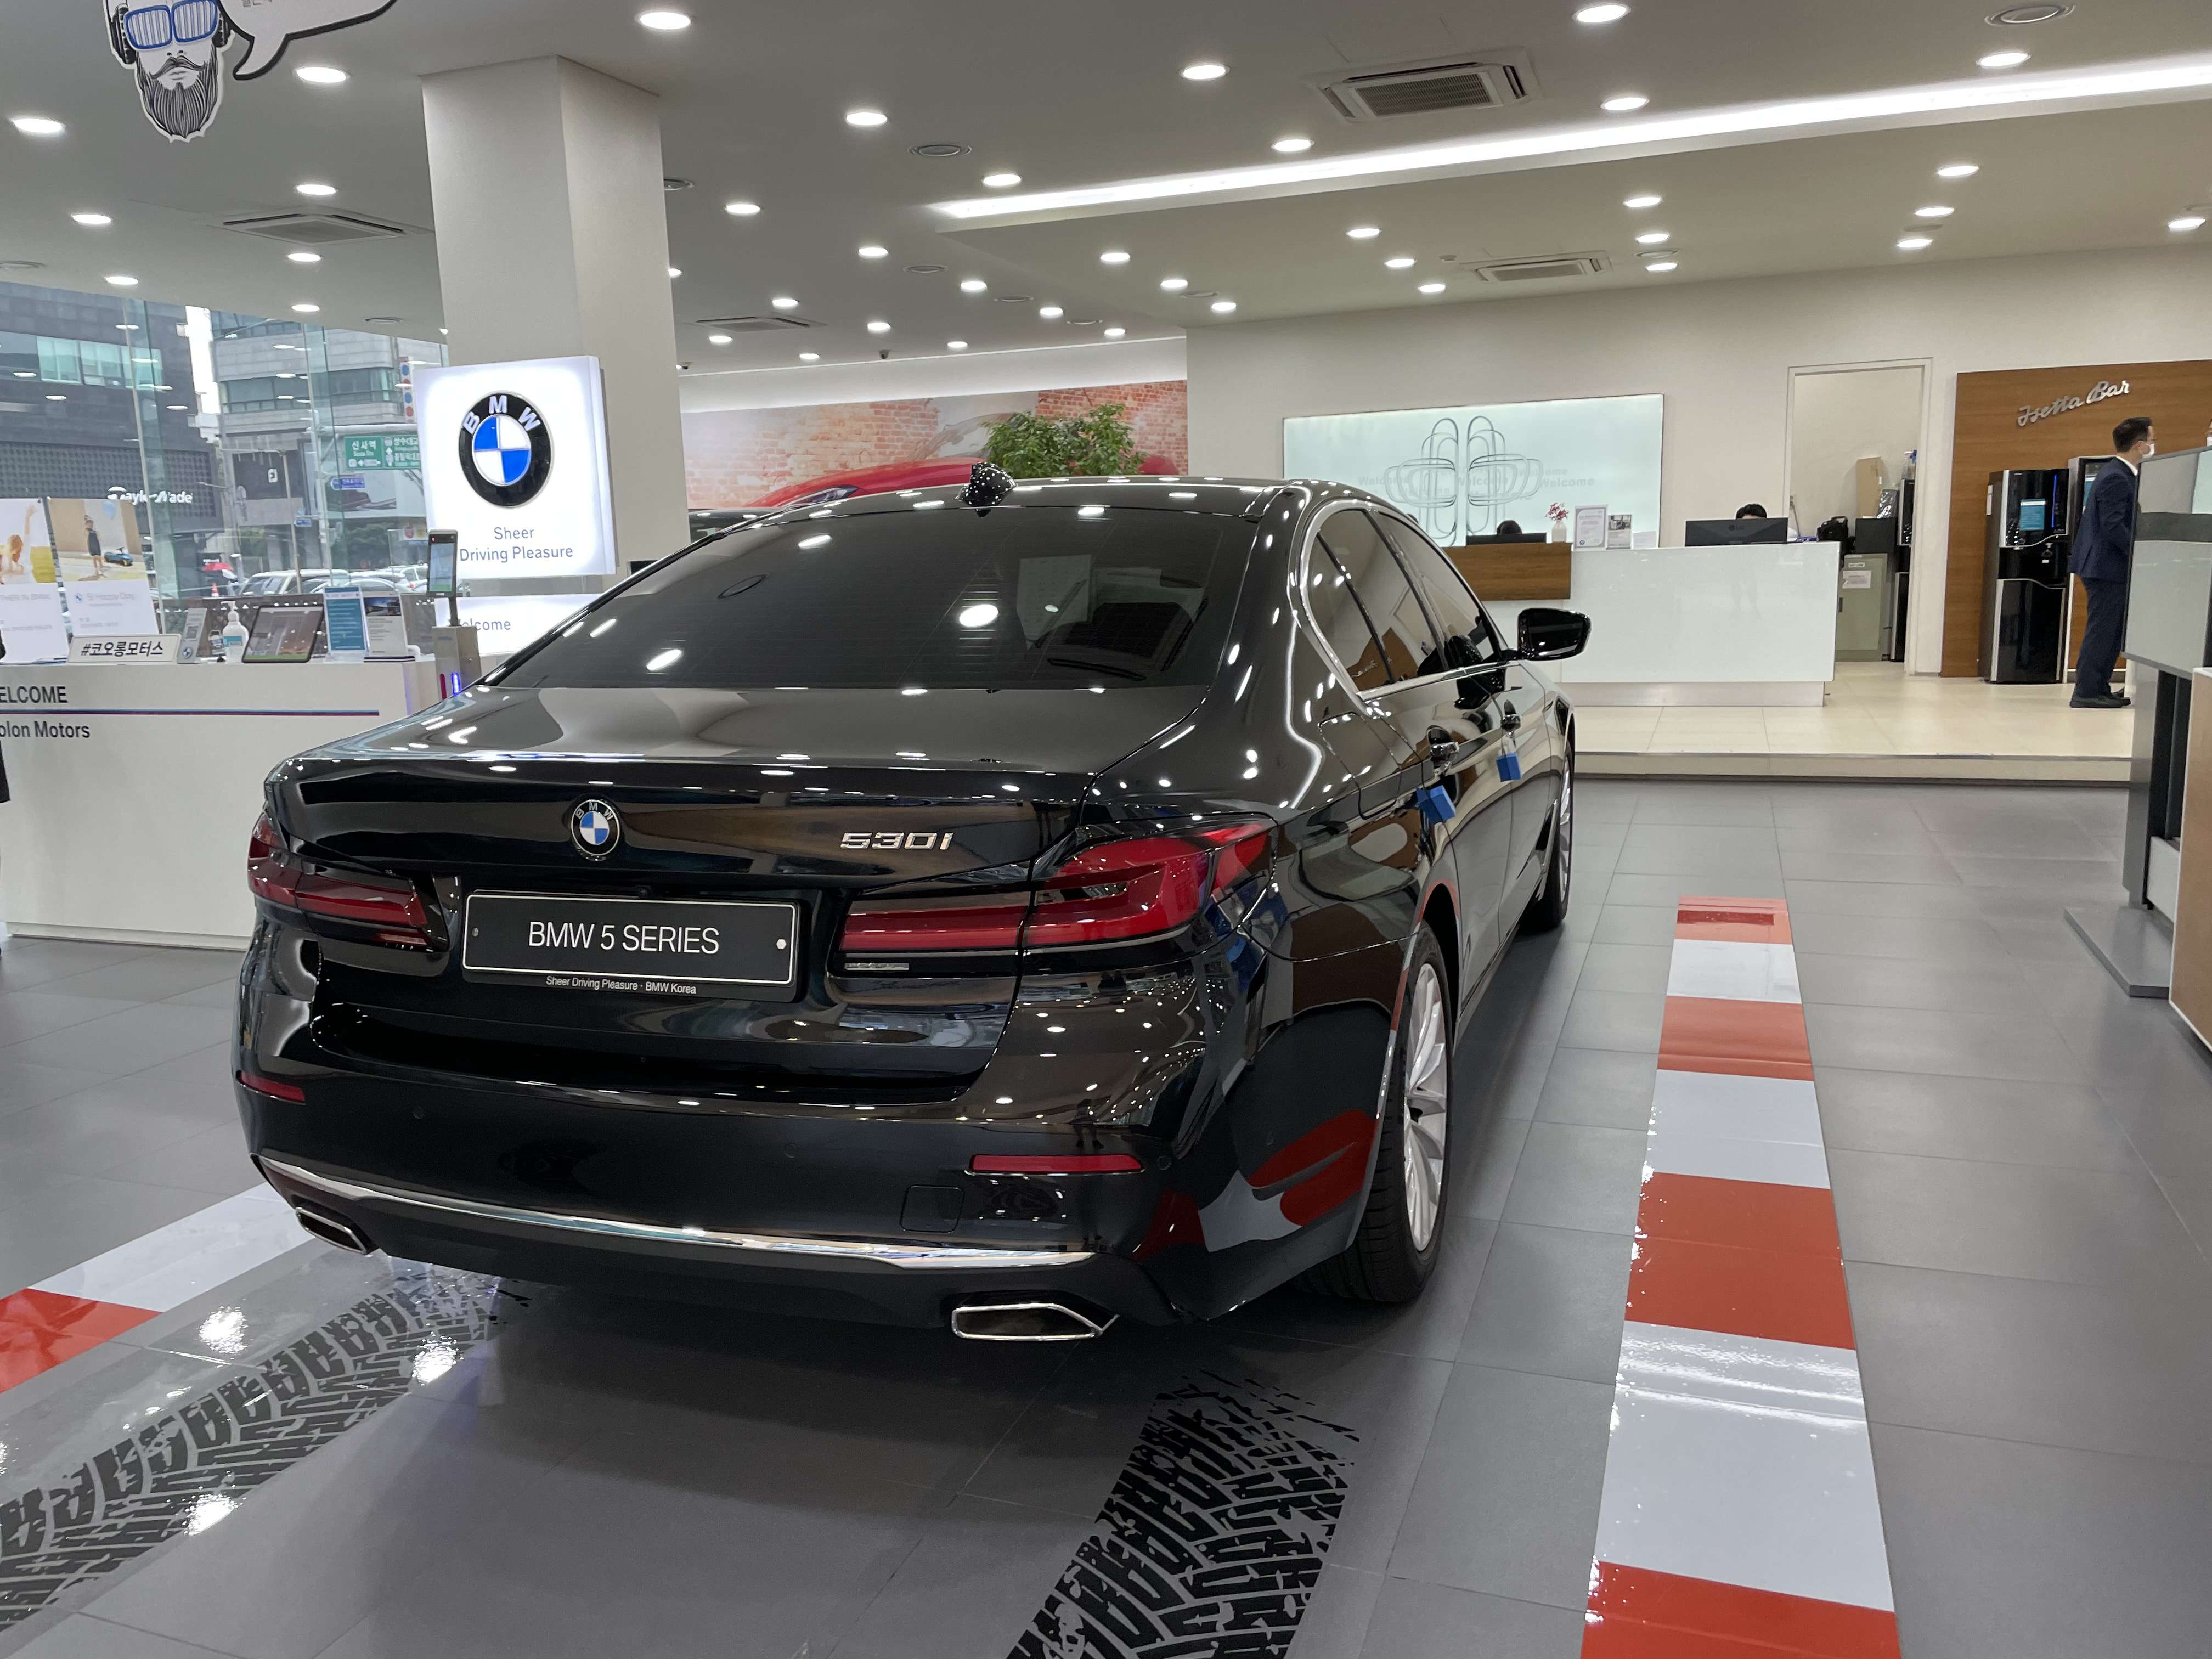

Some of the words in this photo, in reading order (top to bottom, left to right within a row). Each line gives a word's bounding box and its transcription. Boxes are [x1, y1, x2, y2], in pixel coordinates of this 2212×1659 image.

[2018, 395, 2084, 427] Isetta
[2086, 380, 2130, 404] Bar
[462, 394, 541, 435] BMW
[494, 527, 534, 540] Sheer
[460, 548, 508, 563] Driving
[512, 546, 573, 559] Pleasure
[449, 618, 511, 630] lcome
[81, 641, 163, 657] #코오롱모터스
[0, 686, 69, 703] ELCOME
[0, 720, 30, 737] olon
[34, 720, 91, 738] Motors
[575, 802, 614, 820] BMW
[840, 832, 953, 850] 530i
[528, 921, 595, 949] BMW
[600, 924, 615, 950] 5
[622, 924, 720, 955] SERIES
[546, 975, 570, 986] Sheer
[572, 977, 600, 990] Driving
[602, 979, 638, 991] Pleasure
[645, 981, 669, 992] BMW
[671, 983, 696, 994] Korea
